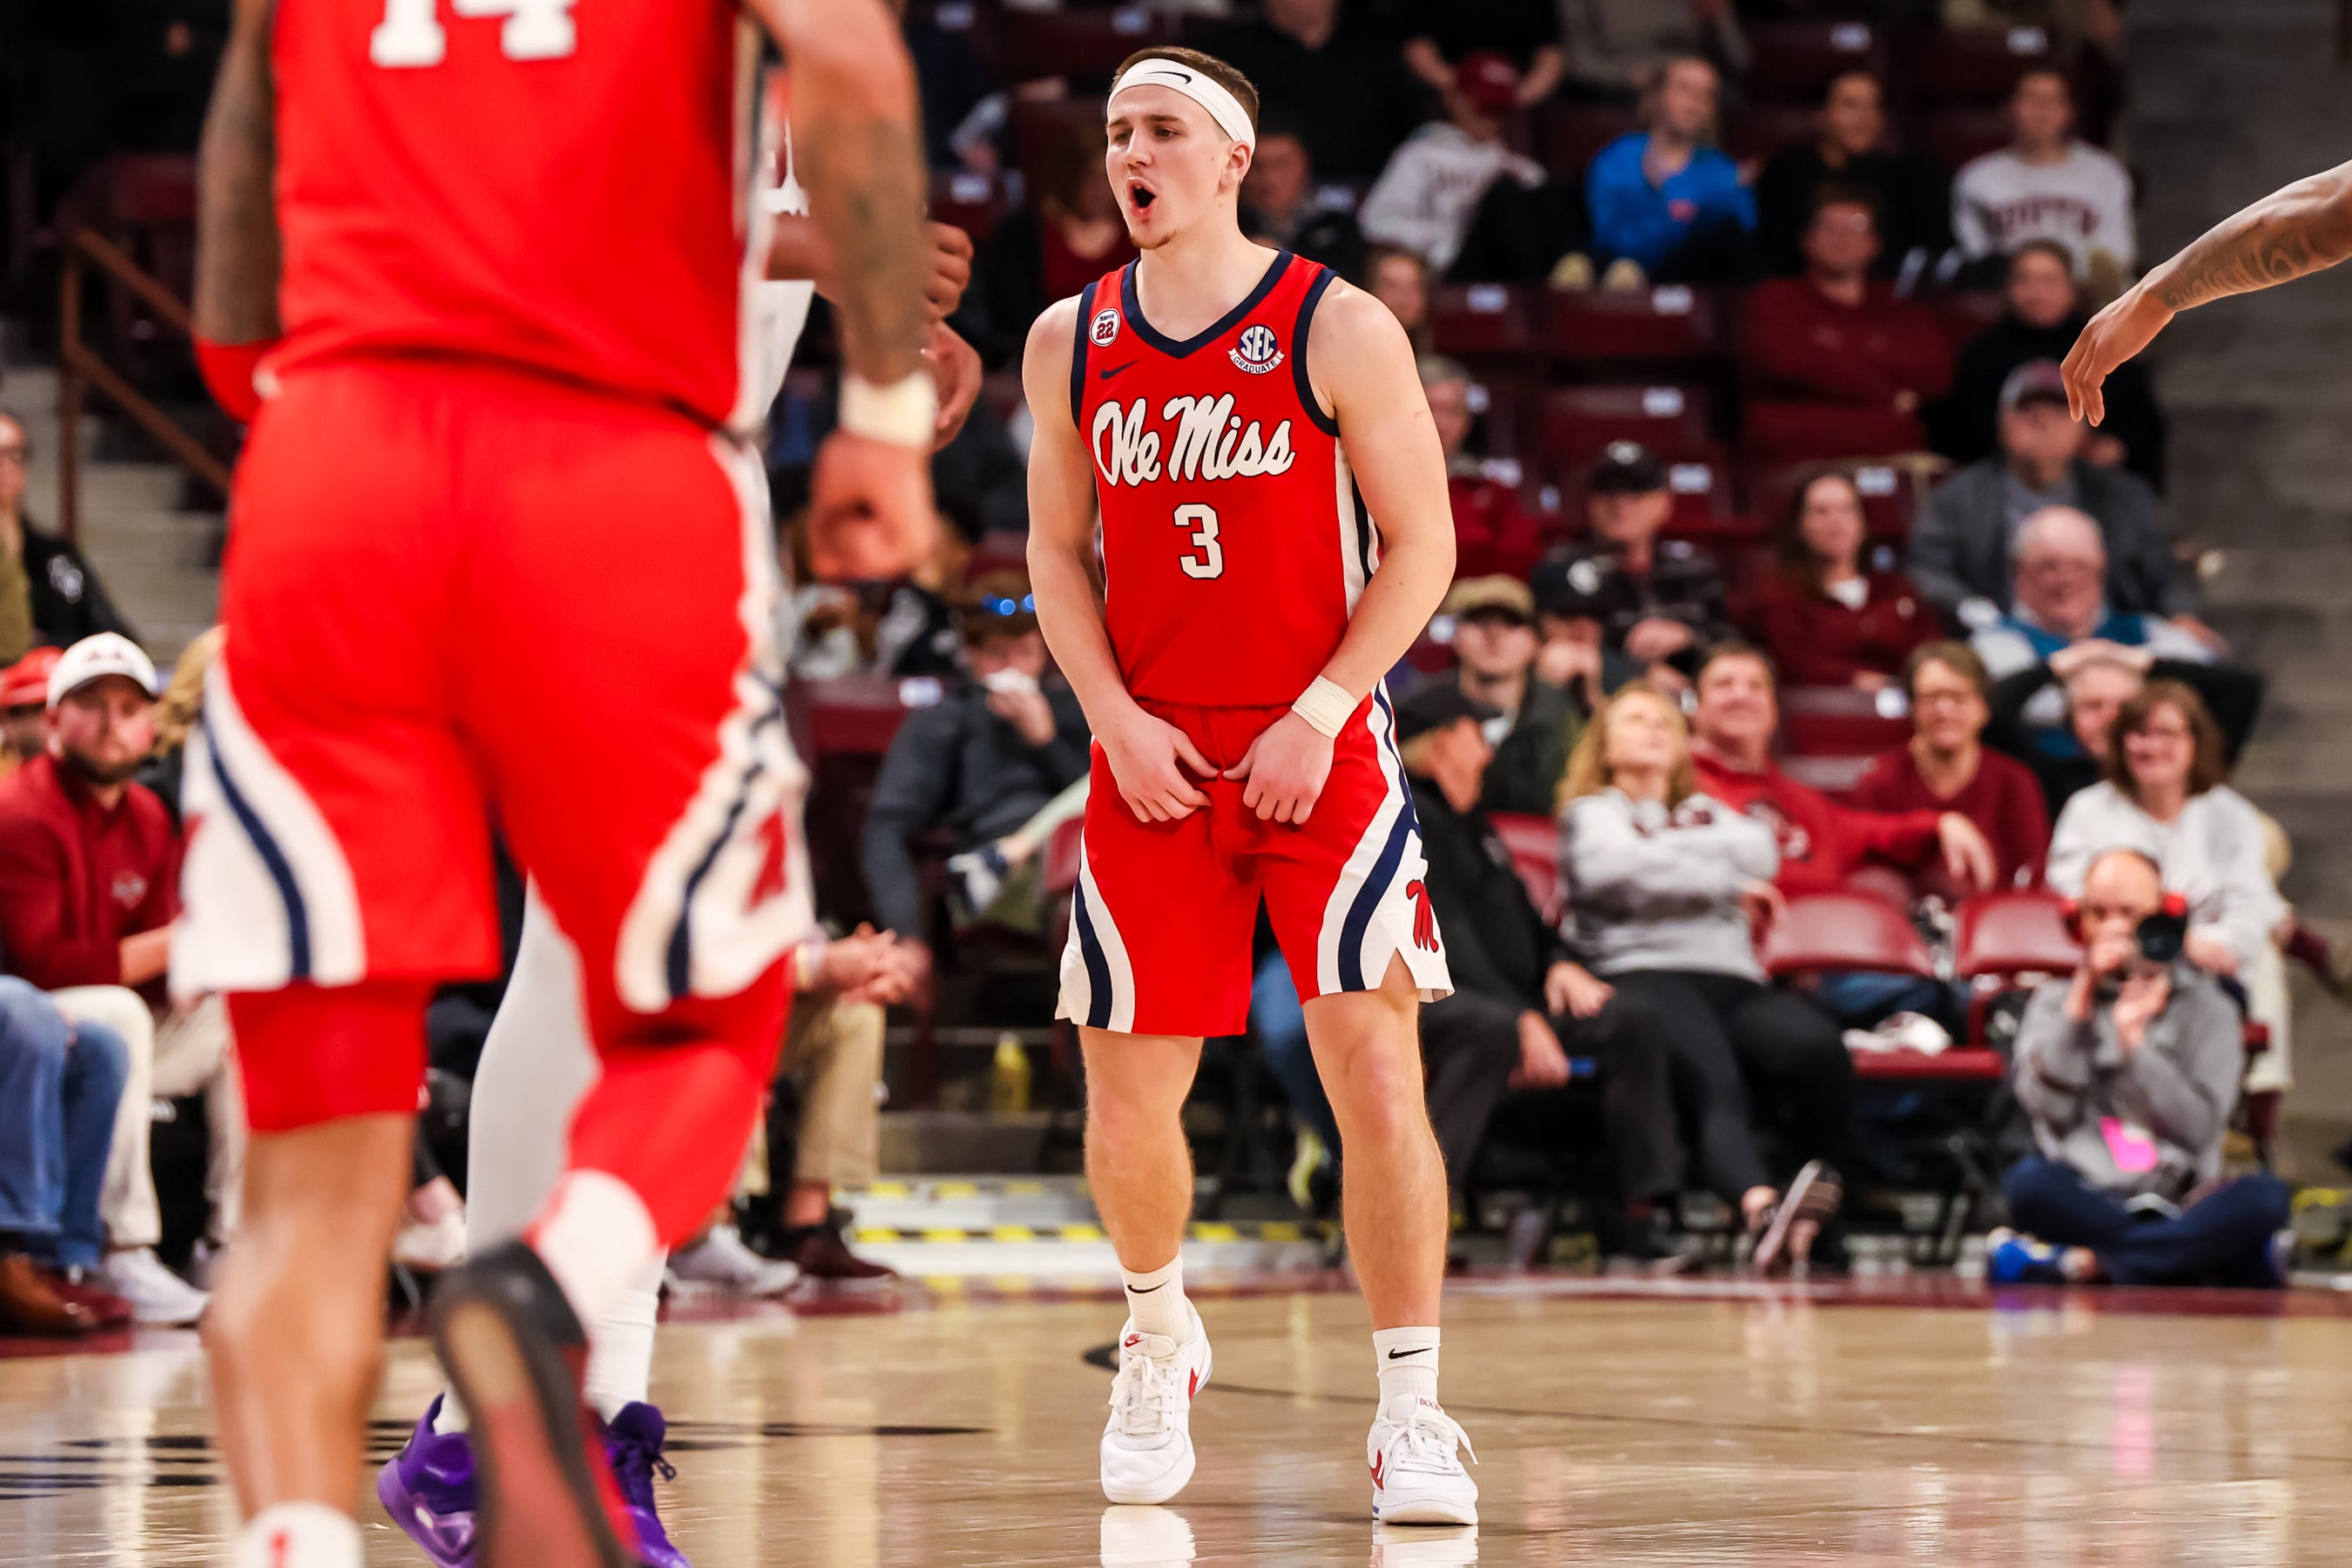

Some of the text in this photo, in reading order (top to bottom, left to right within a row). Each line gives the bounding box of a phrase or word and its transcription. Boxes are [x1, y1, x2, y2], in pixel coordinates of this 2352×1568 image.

[1096, 321, 1114, 340] 22
[1240, 326, 1275, 361] SEC
[1233, 356, 1277, 373] GRADUATE
[1092, 393, 1295, 487] Ole Miss
[1173, 504, 1224, 578] 3
